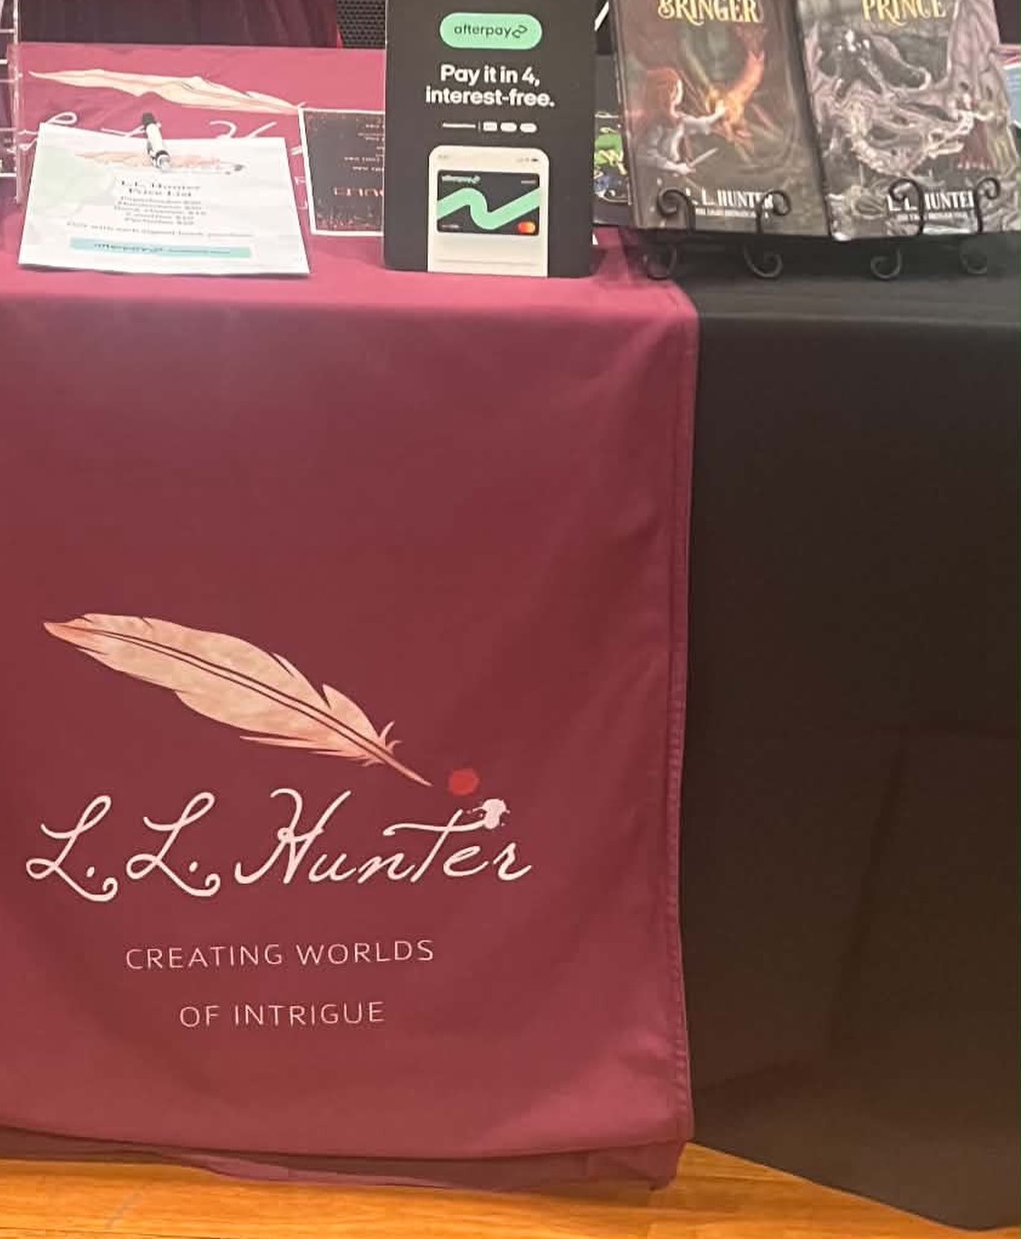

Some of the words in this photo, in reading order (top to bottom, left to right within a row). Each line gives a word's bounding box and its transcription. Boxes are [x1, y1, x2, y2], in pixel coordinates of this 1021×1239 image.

[454, 23, 512, 38] afterpay
[440, 64, 480, 87] Pay
[484, 65, 498, 84] it
[500, 66, 519, 84] in
[521, 67, 541, 87] 4,
[426, 86, 556, 108] interest-free.
[26, 794, 118, 902] L.
[125, 791, 221, 897] L.
[234, 787, 533, 884] Hunter
[125, 944, 284, 971] CREATING
[296, 939, 436, 965] WORLDS
[179, 1005, 219, 1028] OF
[234, 1001, 385, 1027] INTRIGUE
